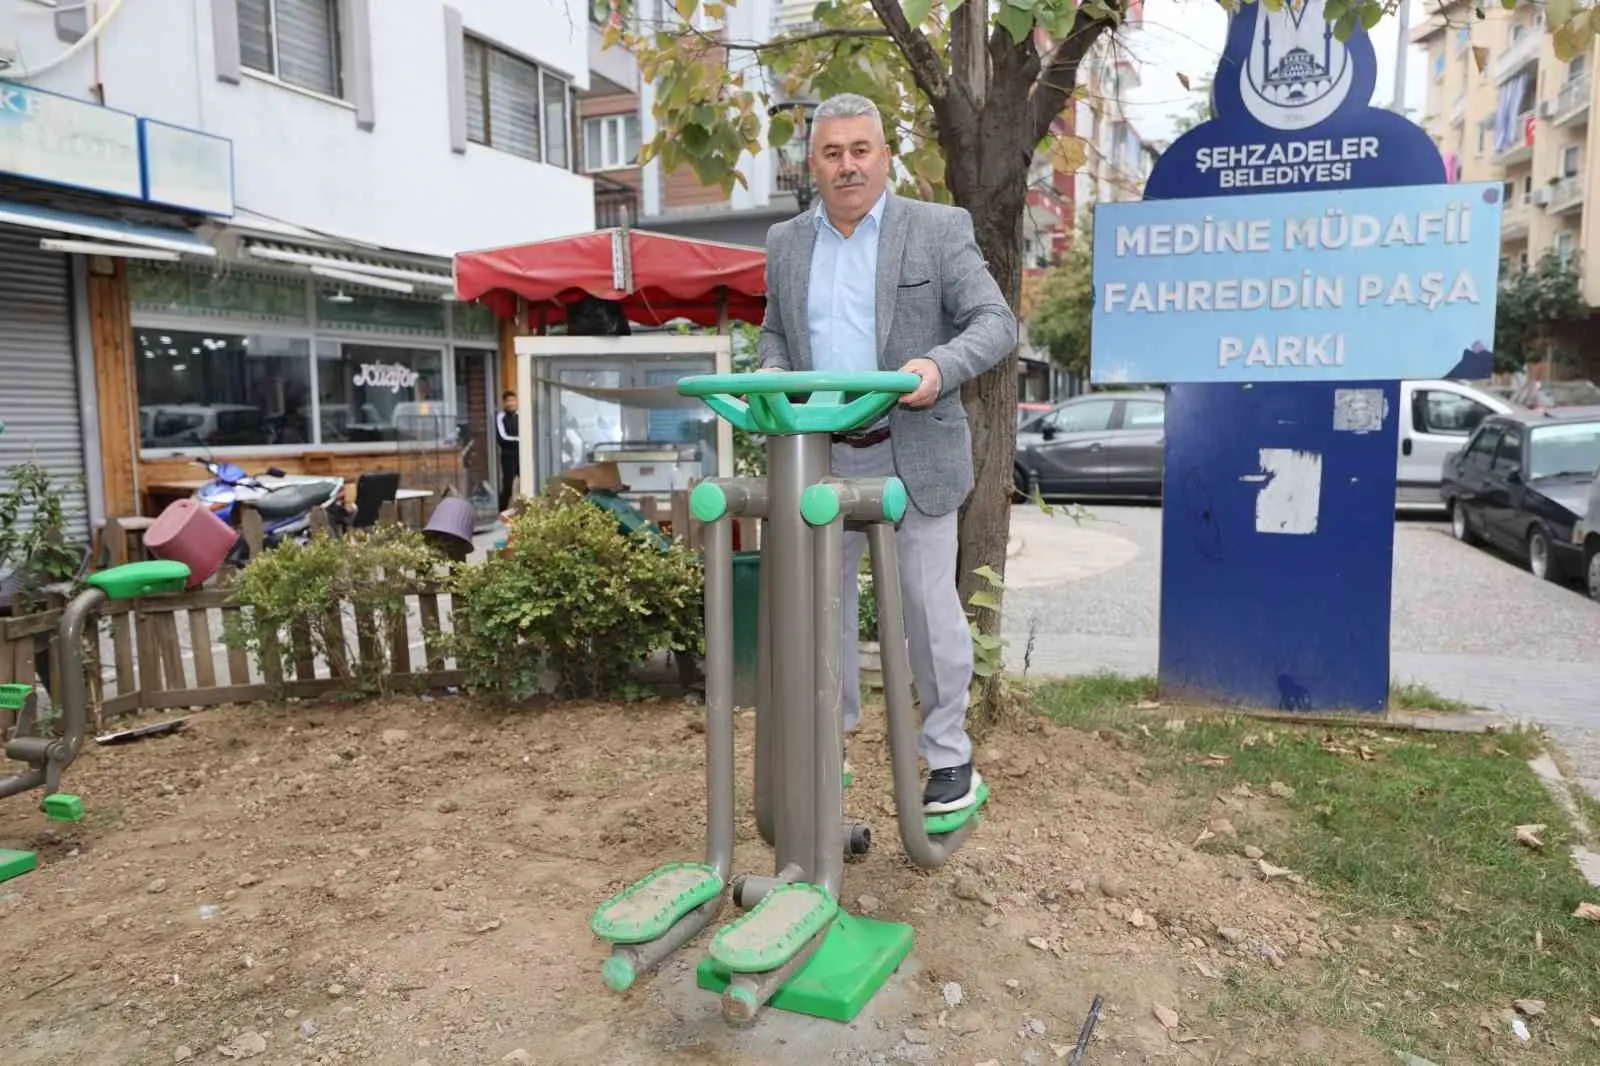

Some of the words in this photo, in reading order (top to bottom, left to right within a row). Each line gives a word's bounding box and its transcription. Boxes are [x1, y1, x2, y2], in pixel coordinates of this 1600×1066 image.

[1196, 136, 1380, 172] ŞEHZADELER
[1219, 162, 1352, 188] BELEDİYESİ
[1115, 215, 1272, 257] MEDİNE
[1283, 203, 1472, 251] MÜDAFİİ
[1103, 270, 1344, 313] FAHREDDİN
[1358, 270, 1480, 311] PAŞA
[1217, 334, 1346, 368] PARKI
